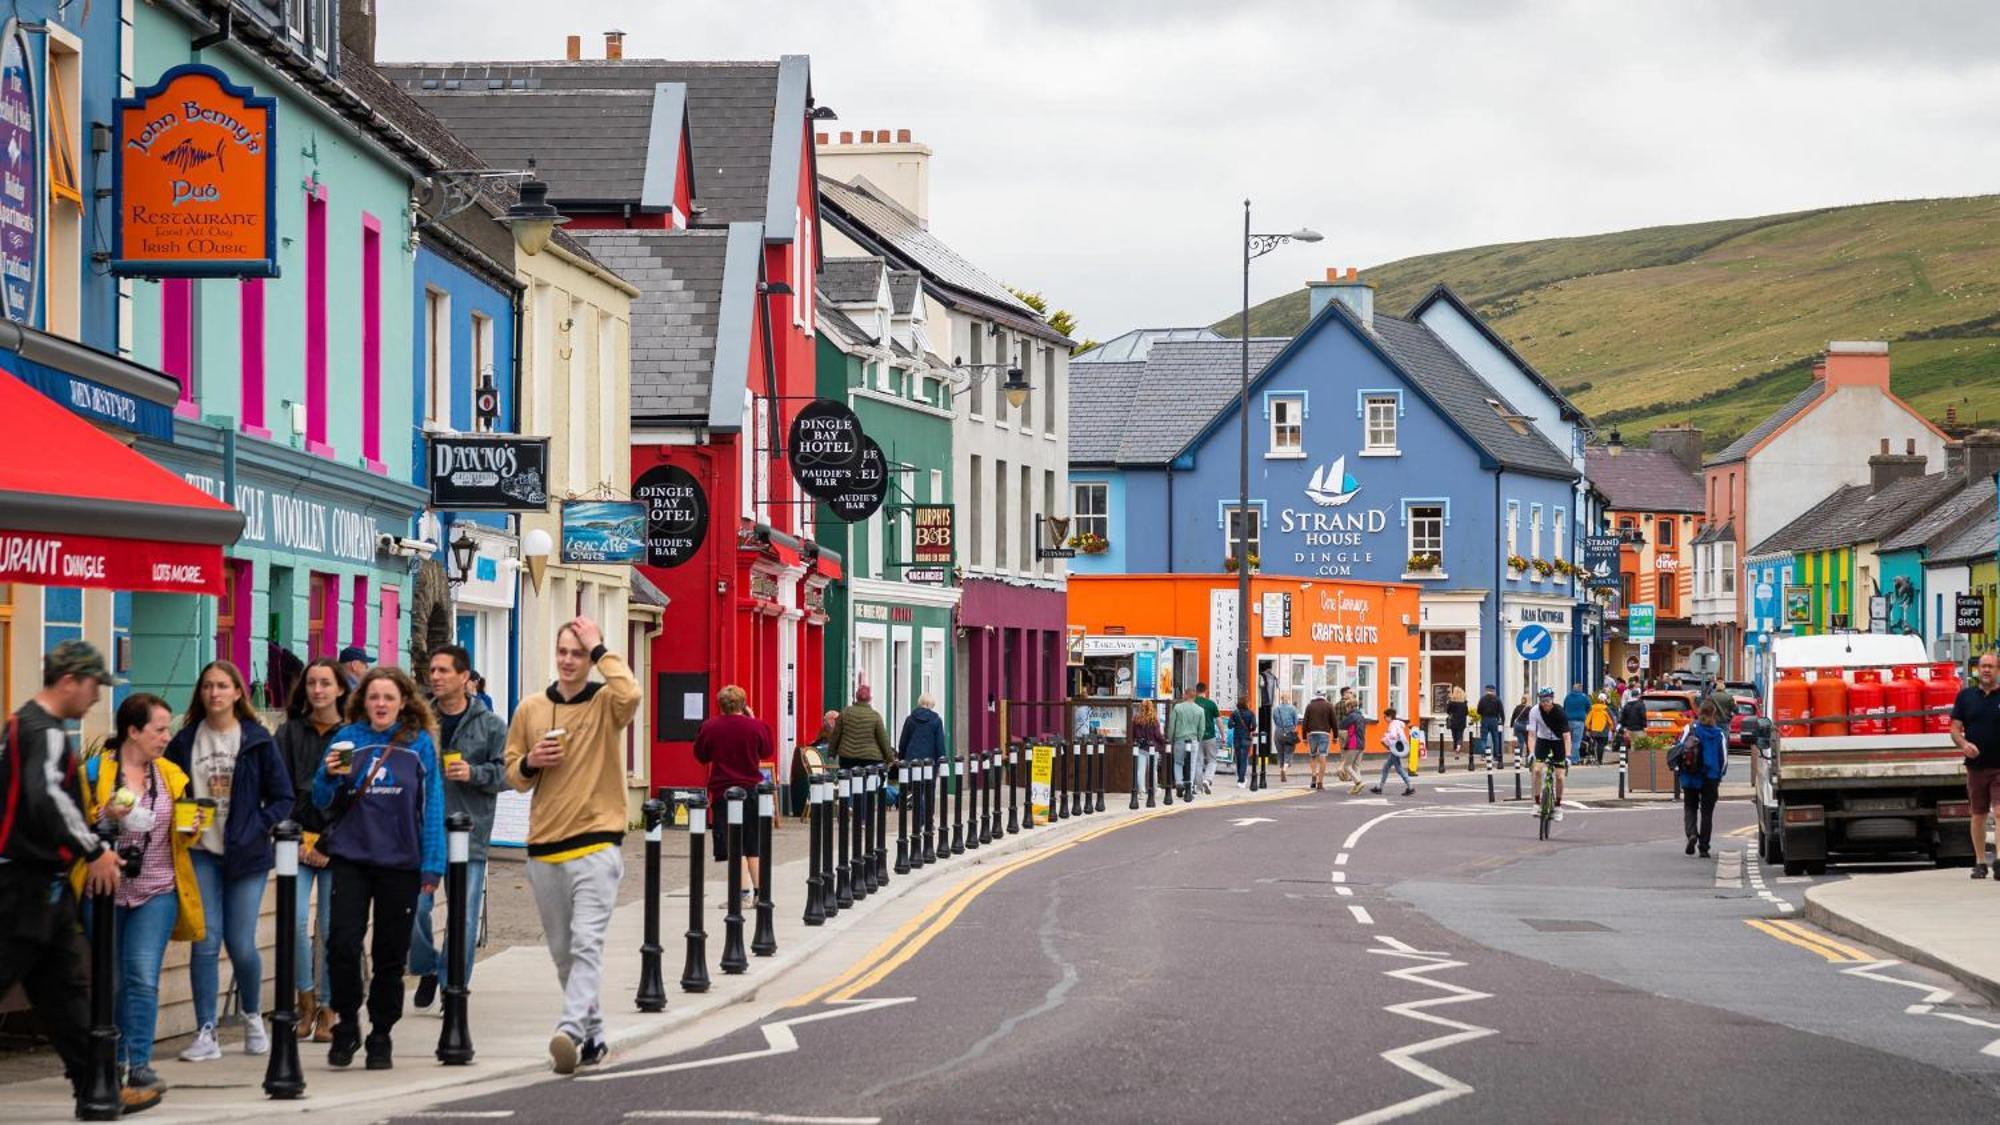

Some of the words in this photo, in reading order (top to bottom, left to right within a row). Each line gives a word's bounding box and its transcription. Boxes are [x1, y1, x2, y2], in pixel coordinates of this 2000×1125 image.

[128, 112, 179, 155] John
[183, 101, 262, 155] Benny's
[171, 180, 220, 207] Pub
[800, 419, 853, 430] DINGLE
[814, 431, 839, 441] BAY
[800, 442, 853, 453] HOTEL
[436, 443, 518, 478] DANNO'S
[802, 469, 852, 479] PAUDIE'S
[640, 487, 695, 497] DINGLE
[654, 498, 680, 508] BAY
[834, 494, 878, 502] AUDIE'S
[648, 510, 695, 521] OTEL
[1281, 508, 1387, 533] STRAND
[272, 494, 328, 554] WOOLLEN
[332, 508, 377, 562] COMPANY
[915, 527, 951, 546] B&B
[1306, 532, 1362, 546] HOUSE
[1295, 552, 1373, 563] DINGLE
[908, 571, 944, 581] VACANCIES
[1316, 565, 1352, 576] .COM
[1283, 593, 1291, 637] GIFTS
[1960, 607, 1979, 617] GIFT
[1958, 617, 1982, 626] SHOP
[1311, 622, 1344, 643] CRAFTS
[1345, 624, 1354, 643] &
[1355, 625, 1378, 644] GIFTS
